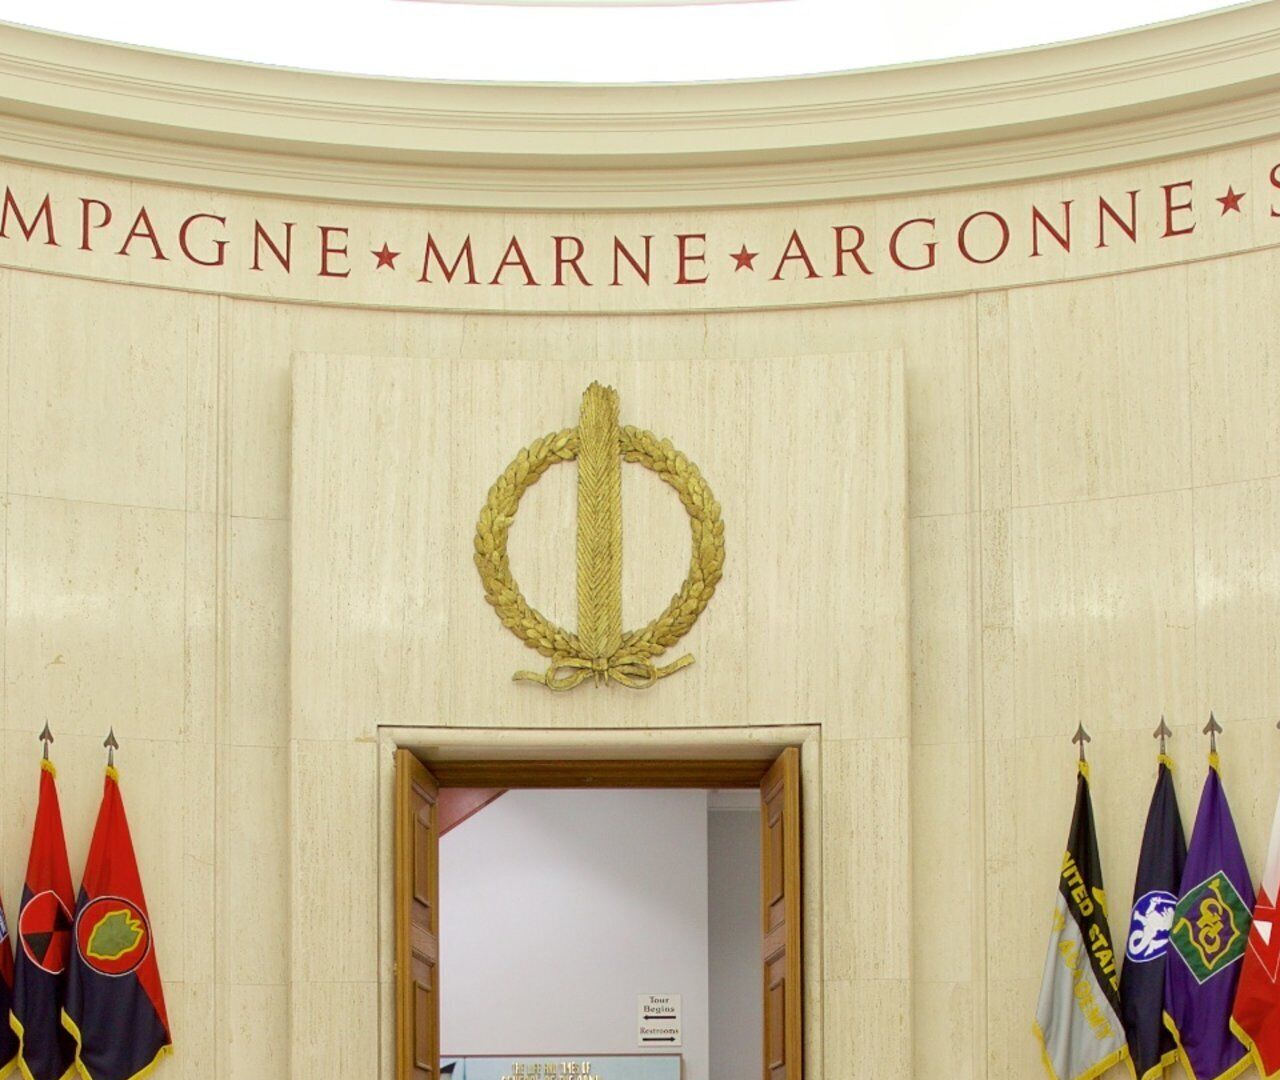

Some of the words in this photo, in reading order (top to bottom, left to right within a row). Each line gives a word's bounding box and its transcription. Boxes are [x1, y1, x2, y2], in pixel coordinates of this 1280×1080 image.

[417, 232, 710, 286] MARNE
[770, 180, 1198, 281] ARGONNE
[643, 1005, 675, 1014] Begins
